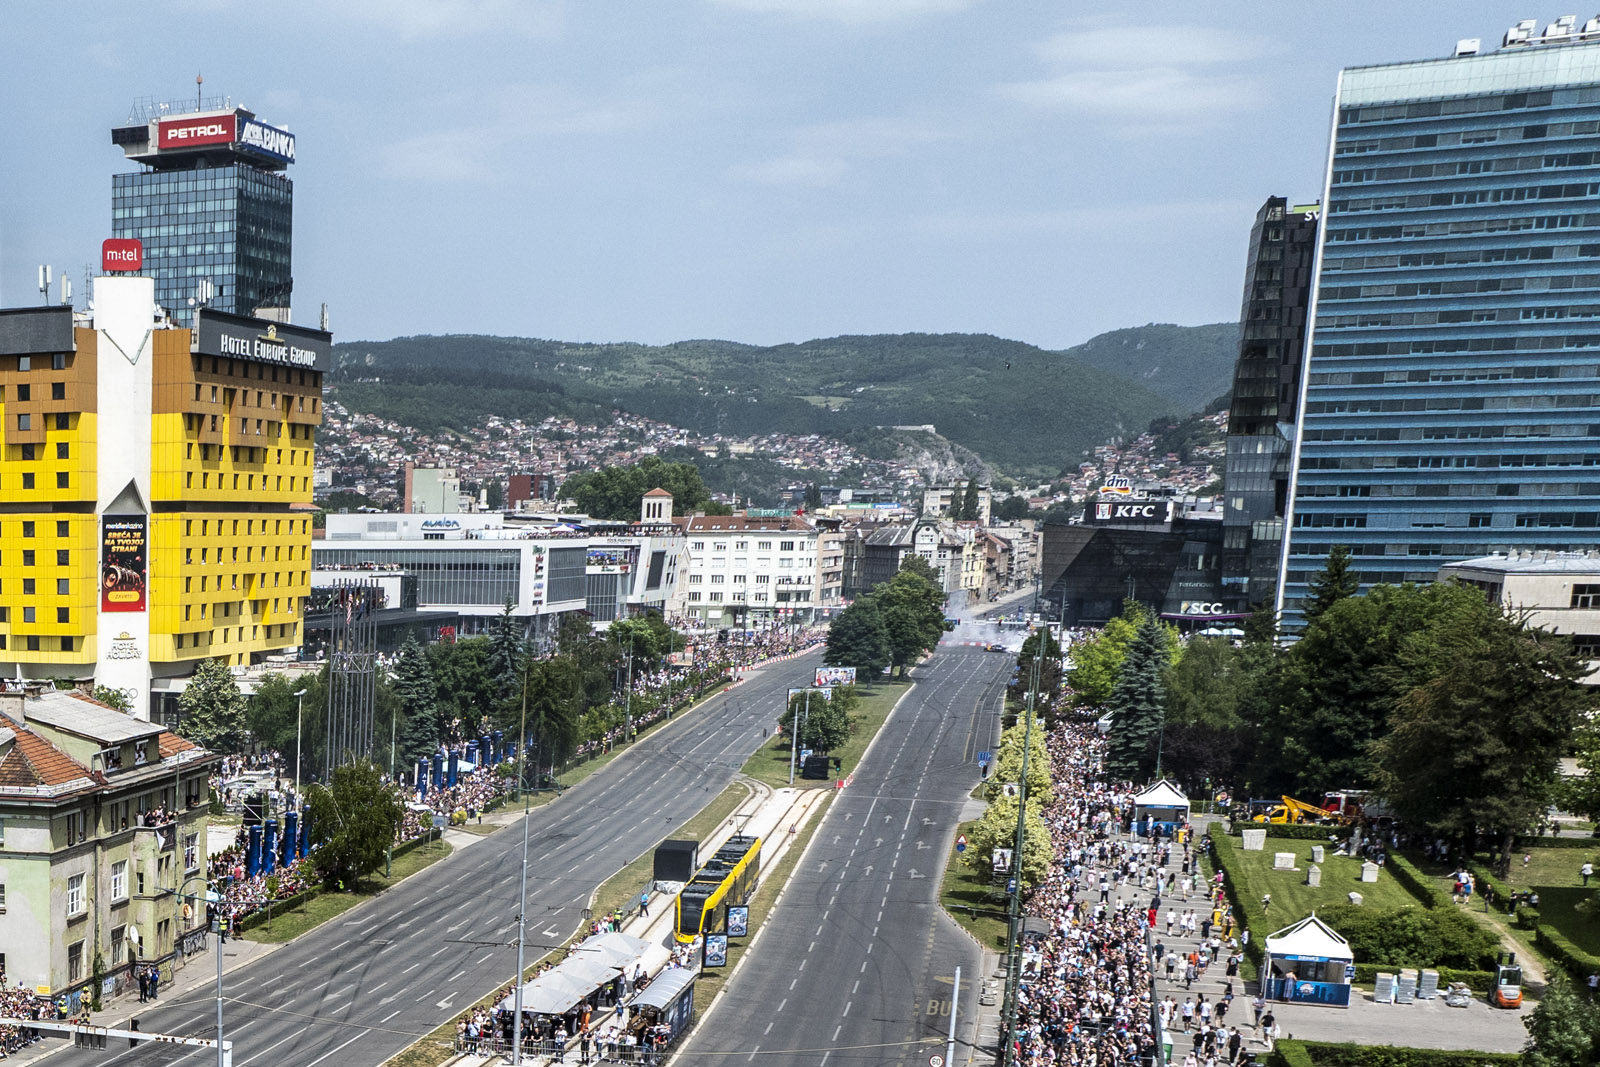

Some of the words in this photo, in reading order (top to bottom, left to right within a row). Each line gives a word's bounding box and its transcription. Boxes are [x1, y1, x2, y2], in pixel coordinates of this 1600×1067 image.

[167, 124, 227, 140] PETROL
[263, 127, 296, 160] BANKA
[106, 248, 138, 261] m:tel
[221, 334, 251, 356] HOTEL
[254, 340, 288, 362] EUROPE
[290, 346, 316, 366] GROUP
[1106, 473, 1128, 487] dm
[1114, 505, 1156, 518] KFC
[1191, 602, 1223, 615] SCC
[932, 1058, 941, 1066] 60
